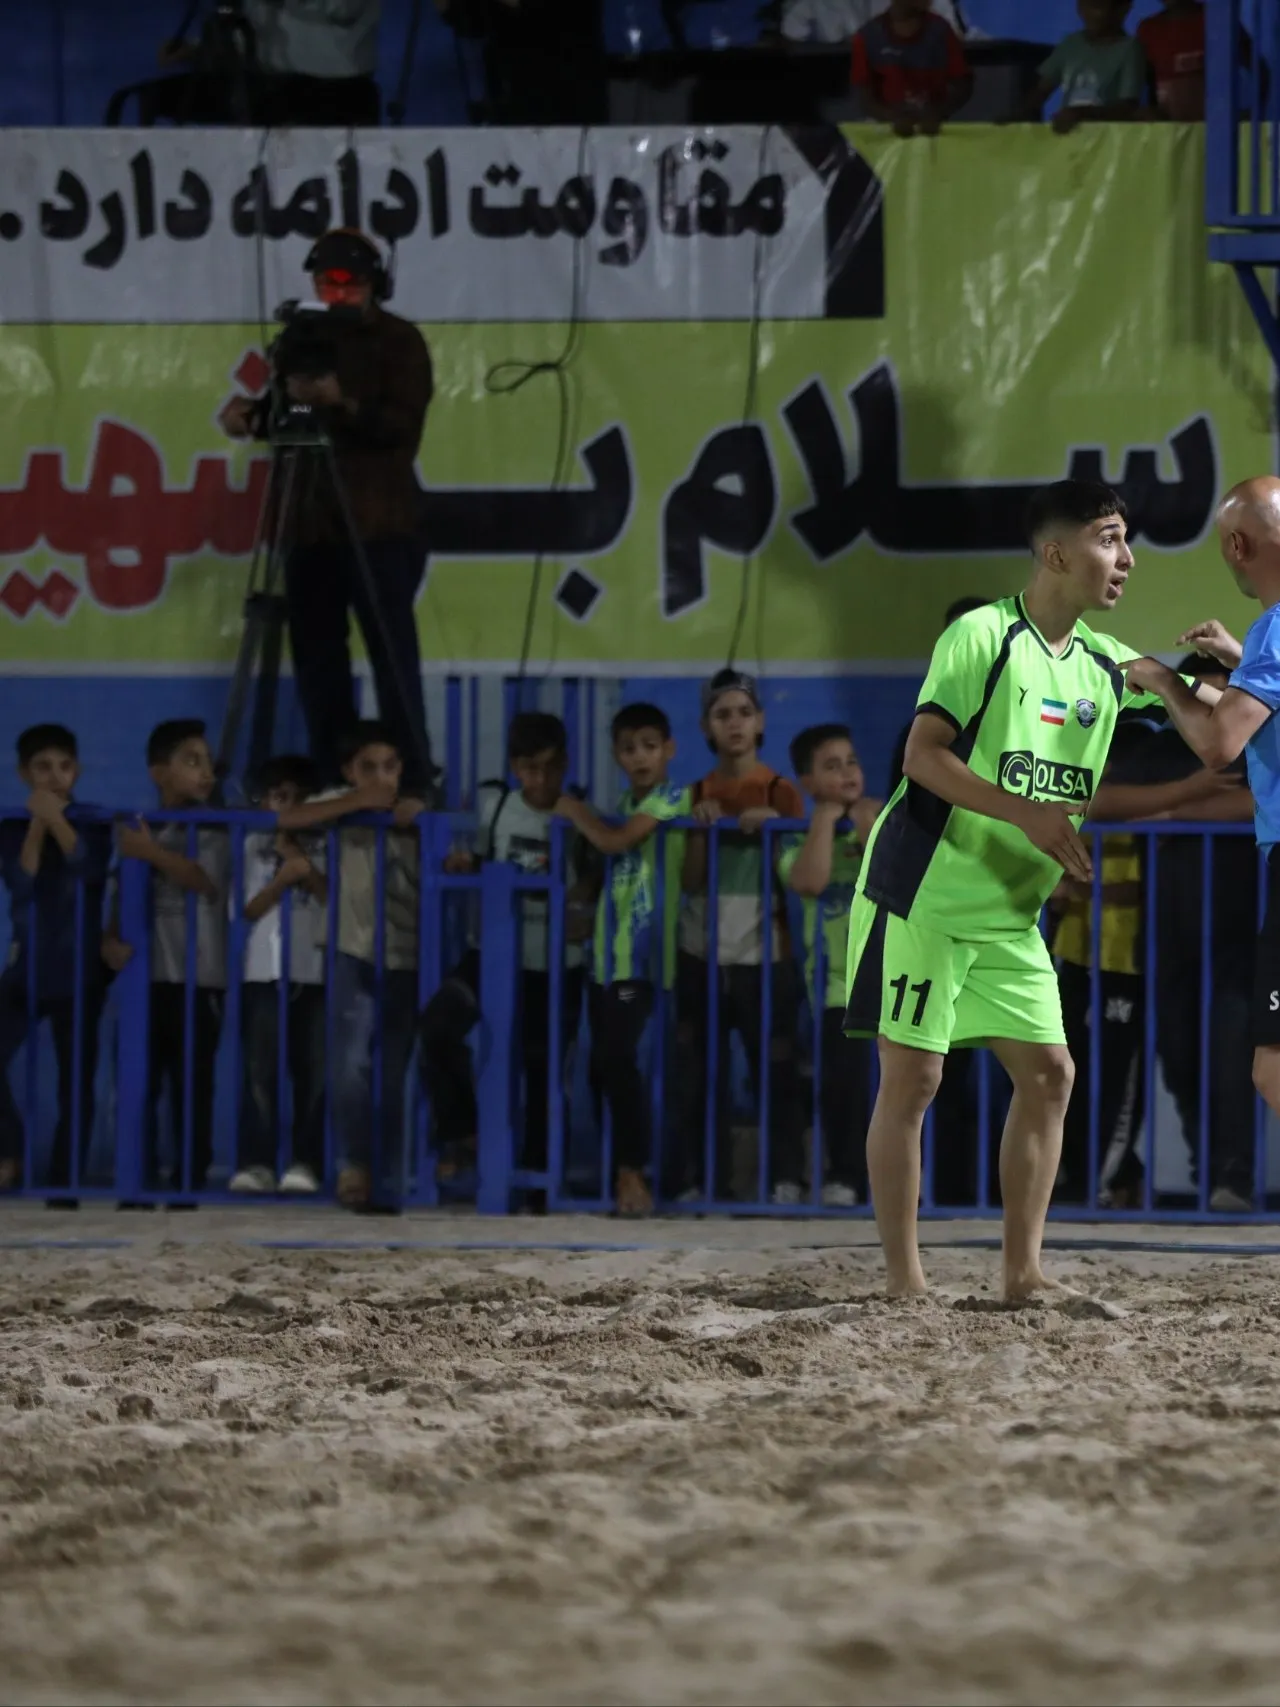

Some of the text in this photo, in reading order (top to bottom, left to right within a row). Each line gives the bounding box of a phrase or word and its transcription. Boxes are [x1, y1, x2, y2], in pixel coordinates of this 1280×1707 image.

[231, 147, 450, 241] ادامه
[470, 139, 785, 268] مقاومت
[662, 359, 1217, 617] سلام
[1001, 753, 1089, 797] GOLSA
[889, 973, 932, 1027] 11
